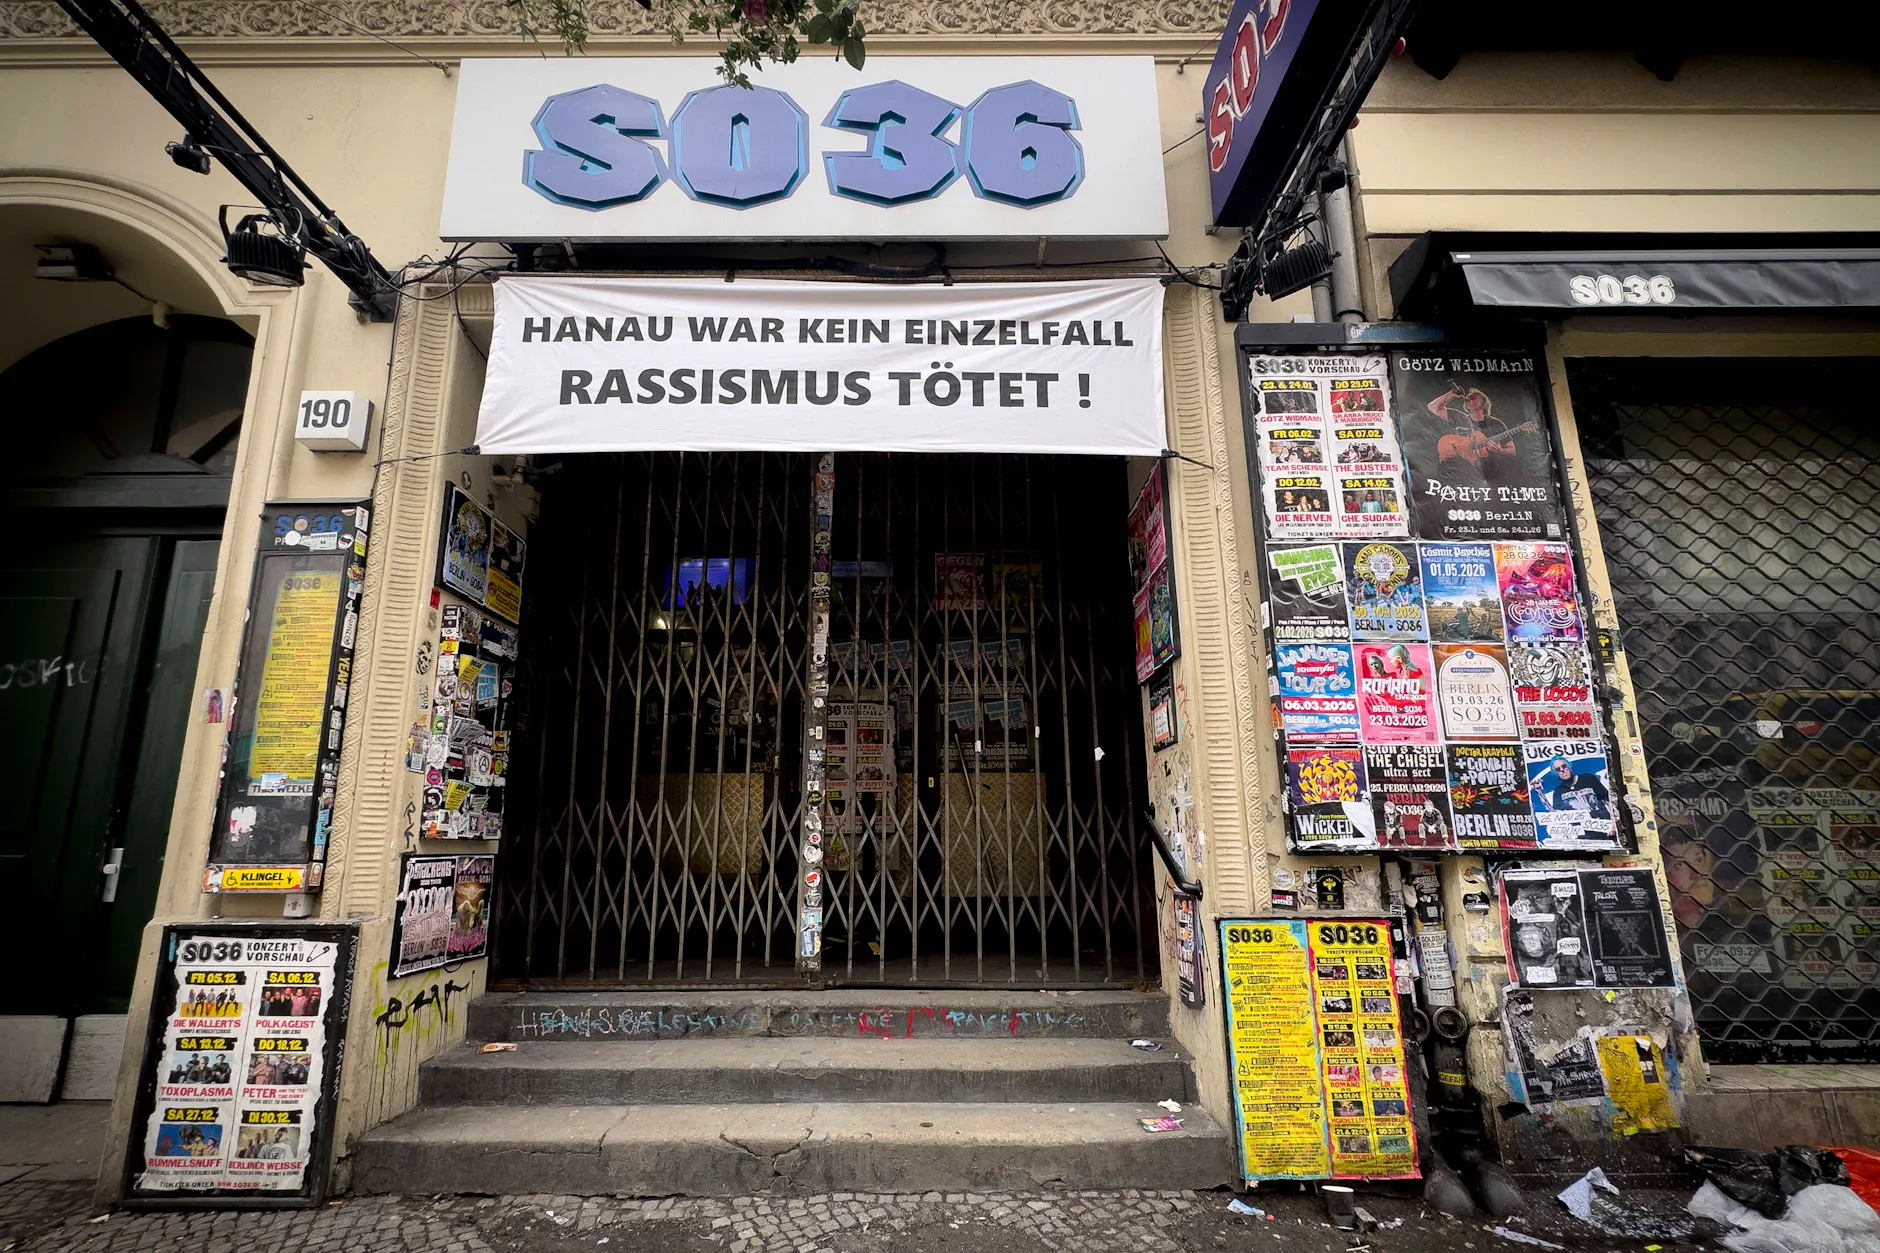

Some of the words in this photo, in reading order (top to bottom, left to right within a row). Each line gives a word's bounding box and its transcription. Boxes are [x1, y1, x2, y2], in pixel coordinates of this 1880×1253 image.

[522, 79, 1085, 212] SO36
[1569, 274, 1676, 306] SO36
[522, 316, 673, 344] HANAU
[688, 316, 787, 344] WAR
[798, 317, 891, 346] KEIN
[903, 318, 1134, 348] EINZELFALL
[1254, 358, 1307, 375] SO36
[1308, 358, 1351, 366] KONZERT
[1309, 365, 1360, 373] VORSCHAU
[558, 368, 873, 407] RASSISMUS
[887, 361, 1060, 409] TÖTET
[1079, 372, 1093, 409] !
[1262, 381, 1275, 389] 23.
[1335, 381, 1349, 389] DO
[301, 399, 351, 428] 190
[1260, 413, 1283, 423] GÖTZ
[1285, 415, 1322, 423] WIDMANN
[1273, 431, 1287, 439] FR
[1338, 430, 1354, 439] SA
[1355, 430, 1382, 438] 07.02.
[1355, 464, 1399, 472] BUSTERS
[1279, 478, 1294, 487] DO
[1295, 478, 1320, 487] 12.02.
[1345, 480, 1362, 488] SA
[1363, 479, 1390, 487] 14.02.
[1275, 514, 1291, 522] DIE
[1292, 514, 1333, 522] NERVEN
[1341, 514, 1360, 522] CHE
[1362, 514, 1404, 522] SUDAKA
[1447, 509, 1481, 521] SO36
[1480, 526, 1496, 534] und
[1272, 547, 1335, 567] DANCING
[1359, 549, 1373, 565] MAD
[1430, 563, 1486, 577] 01.05.2026
[1301, 569, 1337, 591] EYES
[1374, 607, 1391, 618] MAI
[1355, 620, 1386, 631] BERLIN
[1275, 625, 1315, 639] 21.02.2026
[1315, 625, 1349, 638] SO36
[1277, 645, 1350, 667] WUNDER
[1281, 672, 1326, 693] TOUR
[1329, 671, 1351, 691] 26
[1361, 678, 1421, 696] ROMANO
[1450, 683, 1501, 694] BERLIN
[1515, 686, 1542, 702] THE
[1543, 686, 1589, 702] LOCOS
[1284, 700, 1355, 711] 06.03.2026
[1450, 695, 1504, 705] 19.03.26
[1285, 715, 1319, 724] BERLIN
[1328, 715, 1357, 725] SO36
[1452, 707, 1506, 722] SO36
[1522, 711, 1593, 725] 17.03.2026
[1369, 715, 1428, 726] 23.03.2026
[1528, 728, 1559, 738] BERLIN
[1566, 727, 1590, 738] SO36
[1554, 742, 1597, 757] SUBS
[1368, 755, 1392, 767] THE
[1395, 754, 1444, 767] CHISEL
[1383, 767, 1408, 777] ultra
[1411, 768, 1431, 777] sect
[1370, 784, 1383, 792] 25.
[1384, 784, 1424, 792] FEBRUAR
[1424, 783, 1446, 792] 2026
[1455, 814, 1511, 836] BERLIN
[1512, 824, 1534, 836] SO36
[241, 872, 284, 881] KLINGEL
[404, 915, 450, 940] 25.10.26
[1228, 927, 1274, 944] SO36
[1318, 924, 1379, 947] SO36
[180, 940, 244, 963] SO36
[246, 942, 297, 952] KONZERT
[404, 940, 425, 957] BERLIN
[246, 952, 304, 962] VORSCHAU
[190, 973, 205, 984] FR
[206, 972, 238, 984] 05.12.
[269, 972, 286, 984] SA
[287, 972, 316, 984] 06.12.
[174, 1019, 187, 1028] DIE
[189, 1019, 241, 1028] WALLERTS
[255, 1019, 316, 1029] POLKAGEIST
[180, 1039, 197, 1049] SA
[200, 1039, 227, 1050] 13.12.
[258, 1040, 275, 1050] DO
[277, 1040, 304, 1050] 18.12.
[160, 1086, 234, 1097] TOXOPLASMA
[242, 1088, 277, 1099] PETER
[167, 1109, 185, 1121] SA
[187, 1109, 215, 1121] 27.12.
[249, 1111, 262, 1124] DI
[262, 1112, 291, 1124] 30.12.
[149, 1158, 223, 1168] RUMMELSNUFF
[228, 1161, 265, 1170] BERLINER
[266, 1161, 302, 1170] WEISSE
